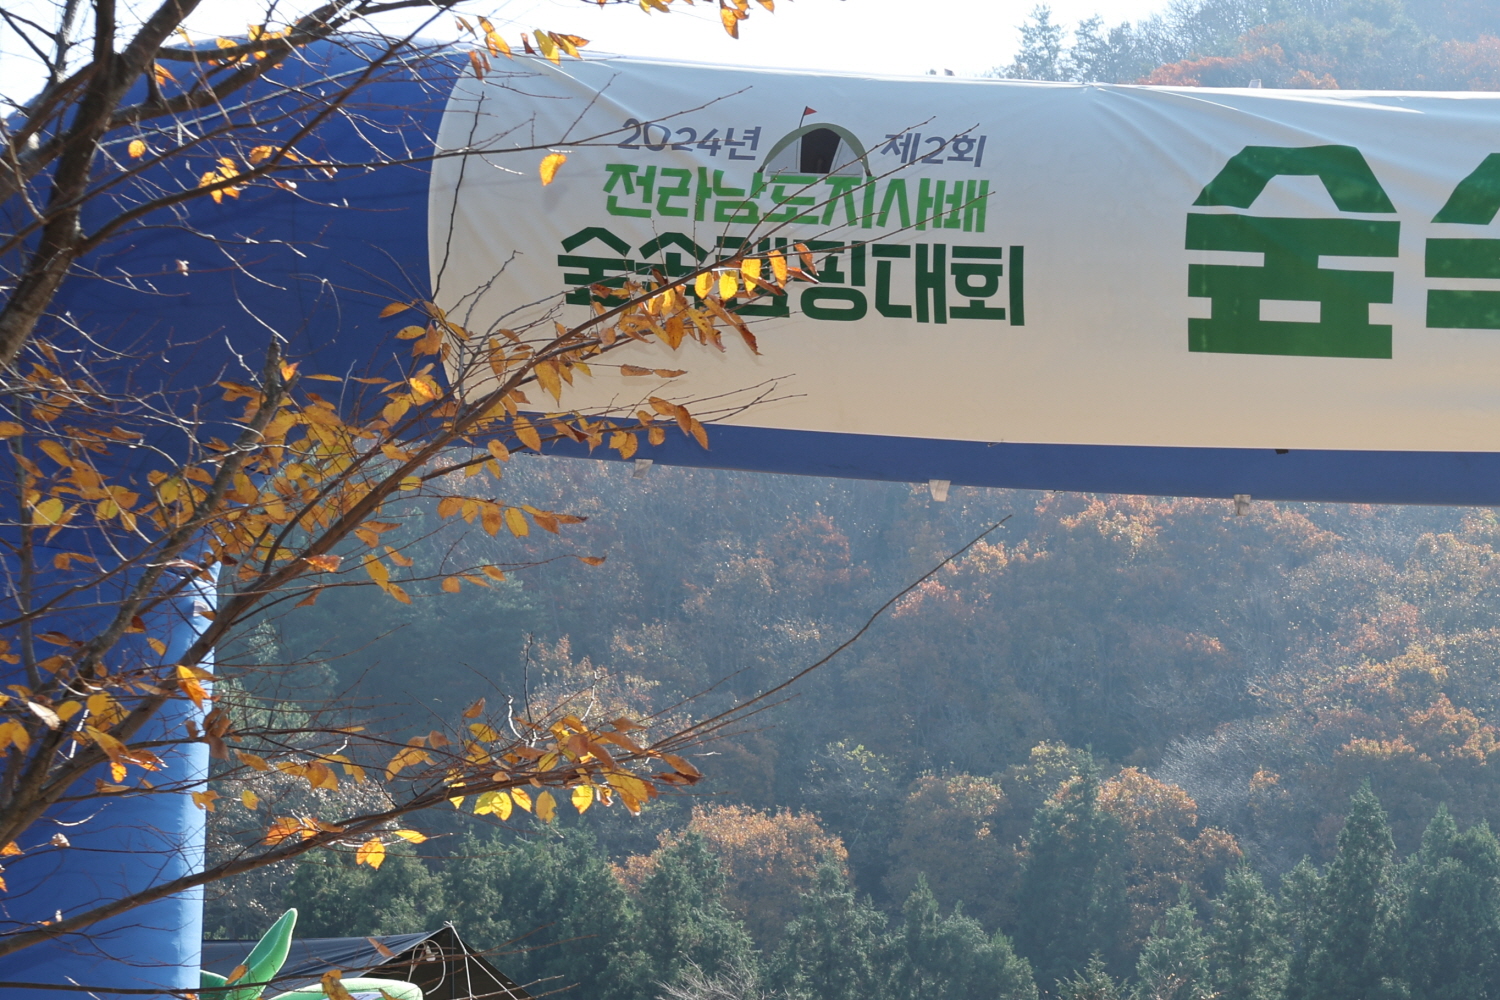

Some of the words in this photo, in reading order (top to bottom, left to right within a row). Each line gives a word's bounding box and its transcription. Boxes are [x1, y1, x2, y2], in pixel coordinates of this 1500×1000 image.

[617, 118, 762, 162] 2024년
[881, 131, 987, 168] 제2회
[602, 163, 990, 233] 전라남도지사배
